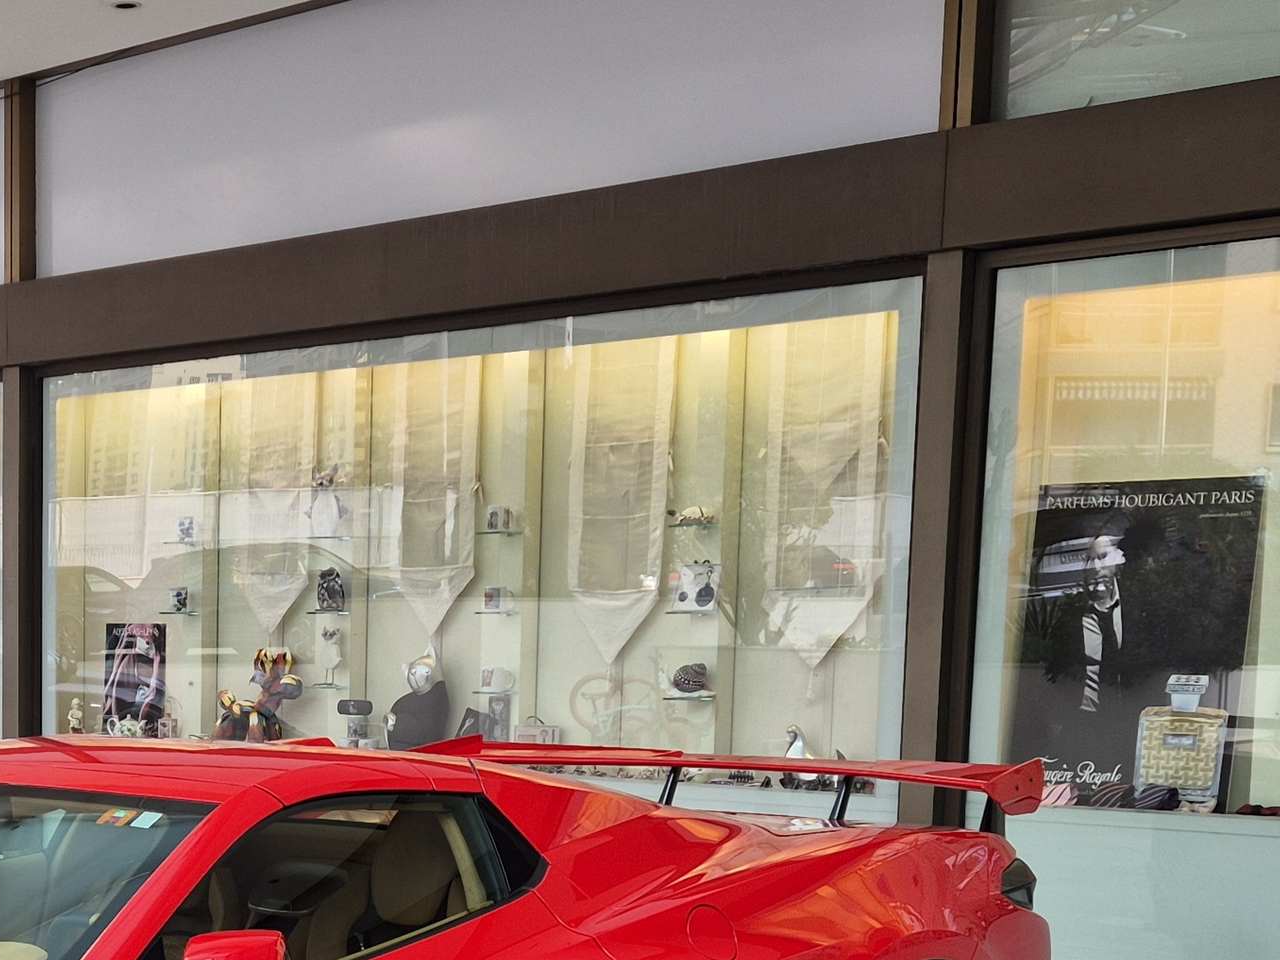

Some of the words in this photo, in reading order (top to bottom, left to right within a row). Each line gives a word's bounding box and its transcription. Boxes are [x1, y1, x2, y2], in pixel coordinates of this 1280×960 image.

[1045, 493, 1112, 511] PARFUMS
[1114, 491, 1208, 509] HOUBIGANT
[1210, 489, 1255, 505] PARIS
[1075, 760, 1122, 789] Royale
